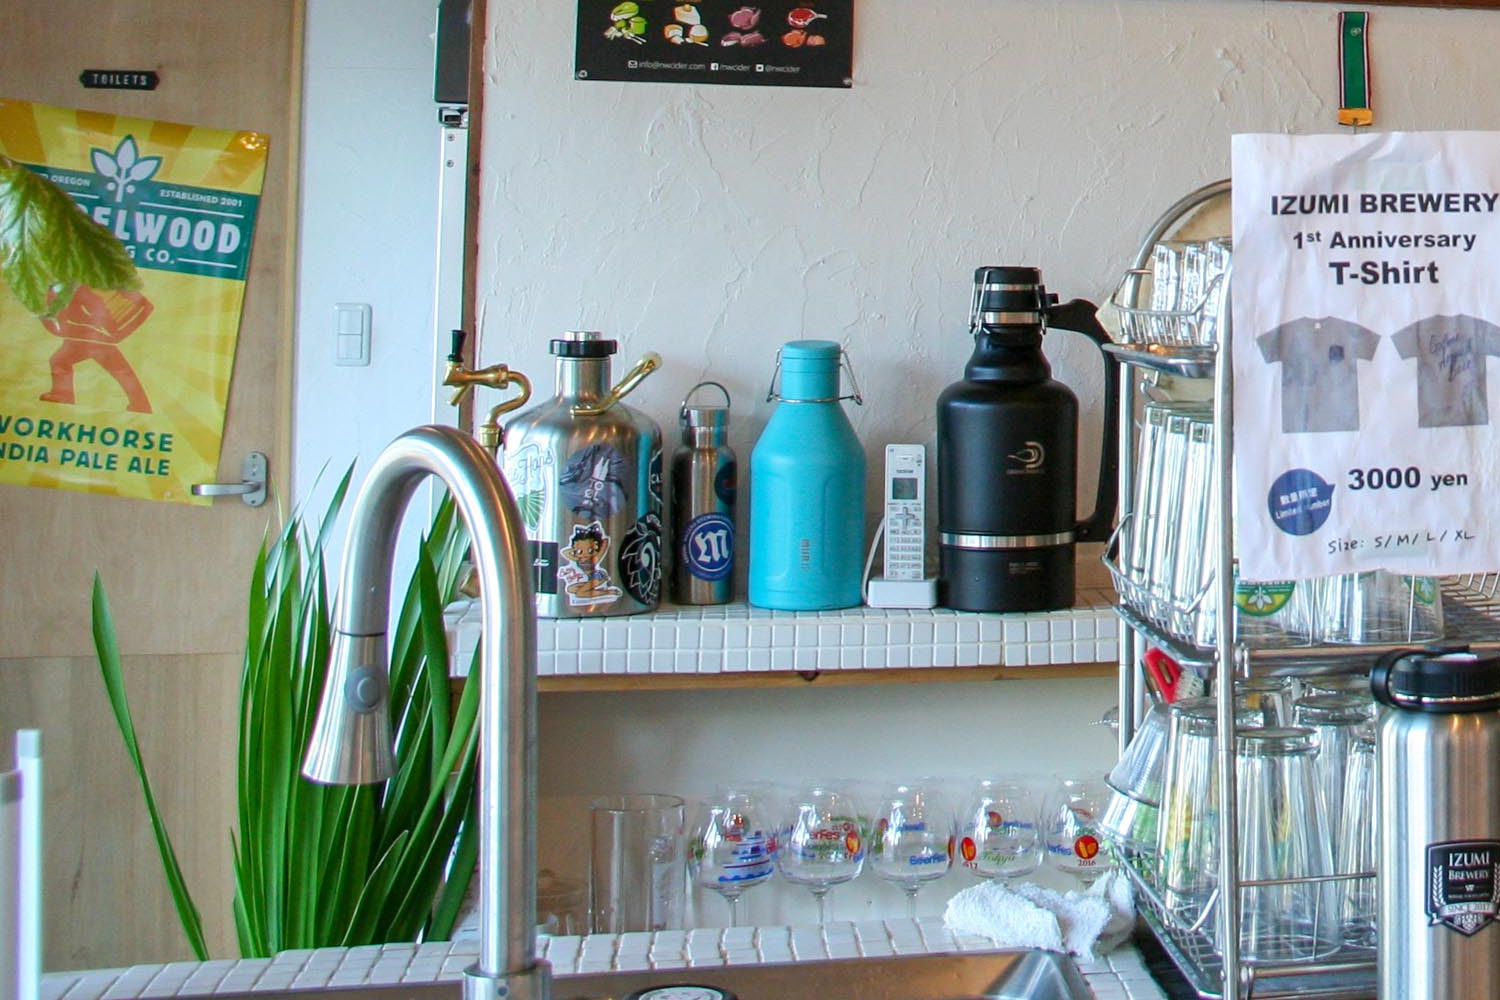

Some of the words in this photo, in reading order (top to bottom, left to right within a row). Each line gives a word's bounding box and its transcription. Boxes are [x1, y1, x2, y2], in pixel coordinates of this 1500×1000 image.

[93, 73, 147, 86] TOILETS
[51, 173, 91, 187] OREGON
[160, 189, 219, 204] ESTABLISHED
[220, 196, 242, 207] 2001
[1271, 194, 1350, 216] IZUMI
[1359, 193, 1500, 214] BREWERY
[1330, 231, 1477, 252] Anniversary
[1329, 261, 1440, 286] T-Shirt
[60, 448, 118, 472] PALE
[128, 454, 171, 476] ALE
[1348, 467, 1421, 491] 3000
[1431, 472, 1468, 490] yen
[1328, 538, 1365, 554] Size:
[1449, 852, 1490, 867] IZUMI
